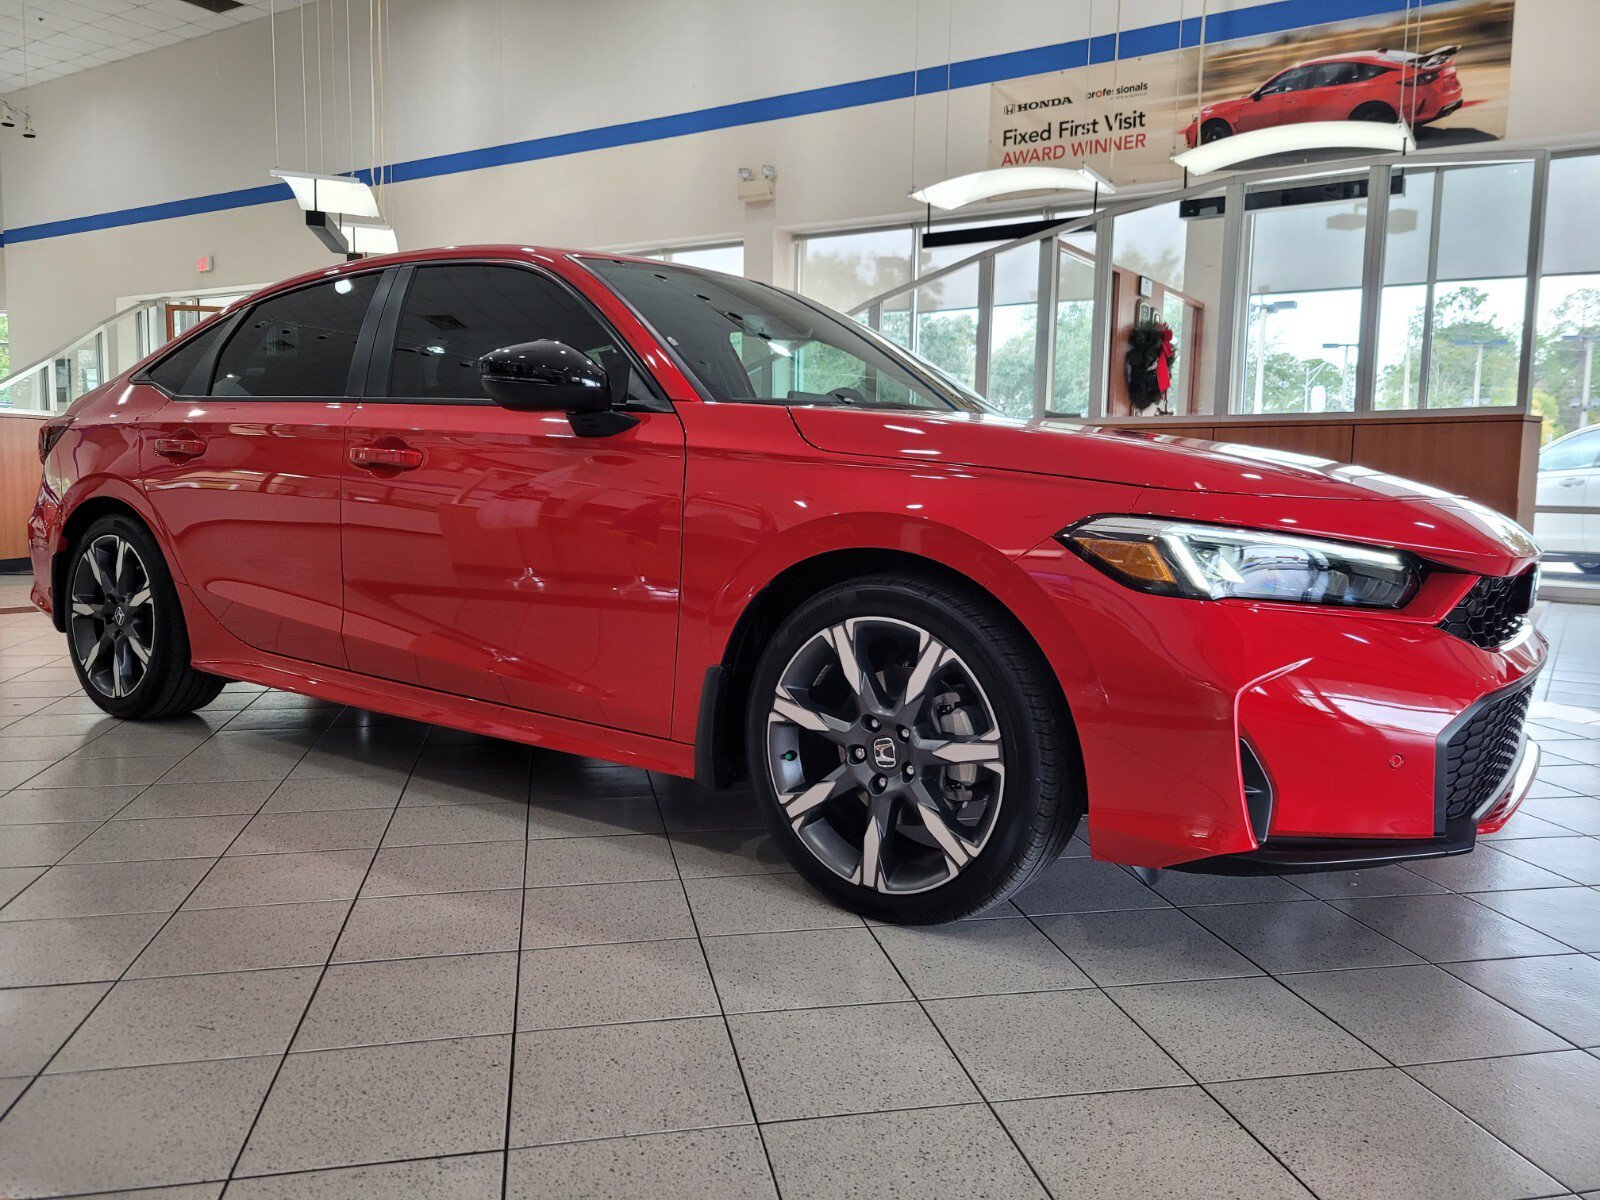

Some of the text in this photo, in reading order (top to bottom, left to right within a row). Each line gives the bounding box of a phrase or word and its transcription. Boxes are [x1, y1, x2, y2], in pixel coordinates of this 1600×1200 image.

[1086, 82, 1148, 99] profesionals
[1018, 97, 1073, 112] HONDA
[1003, 110, 1146, 146] Fixed First Visit
[1001, 133, 1146, 167] AWARD WINNER
